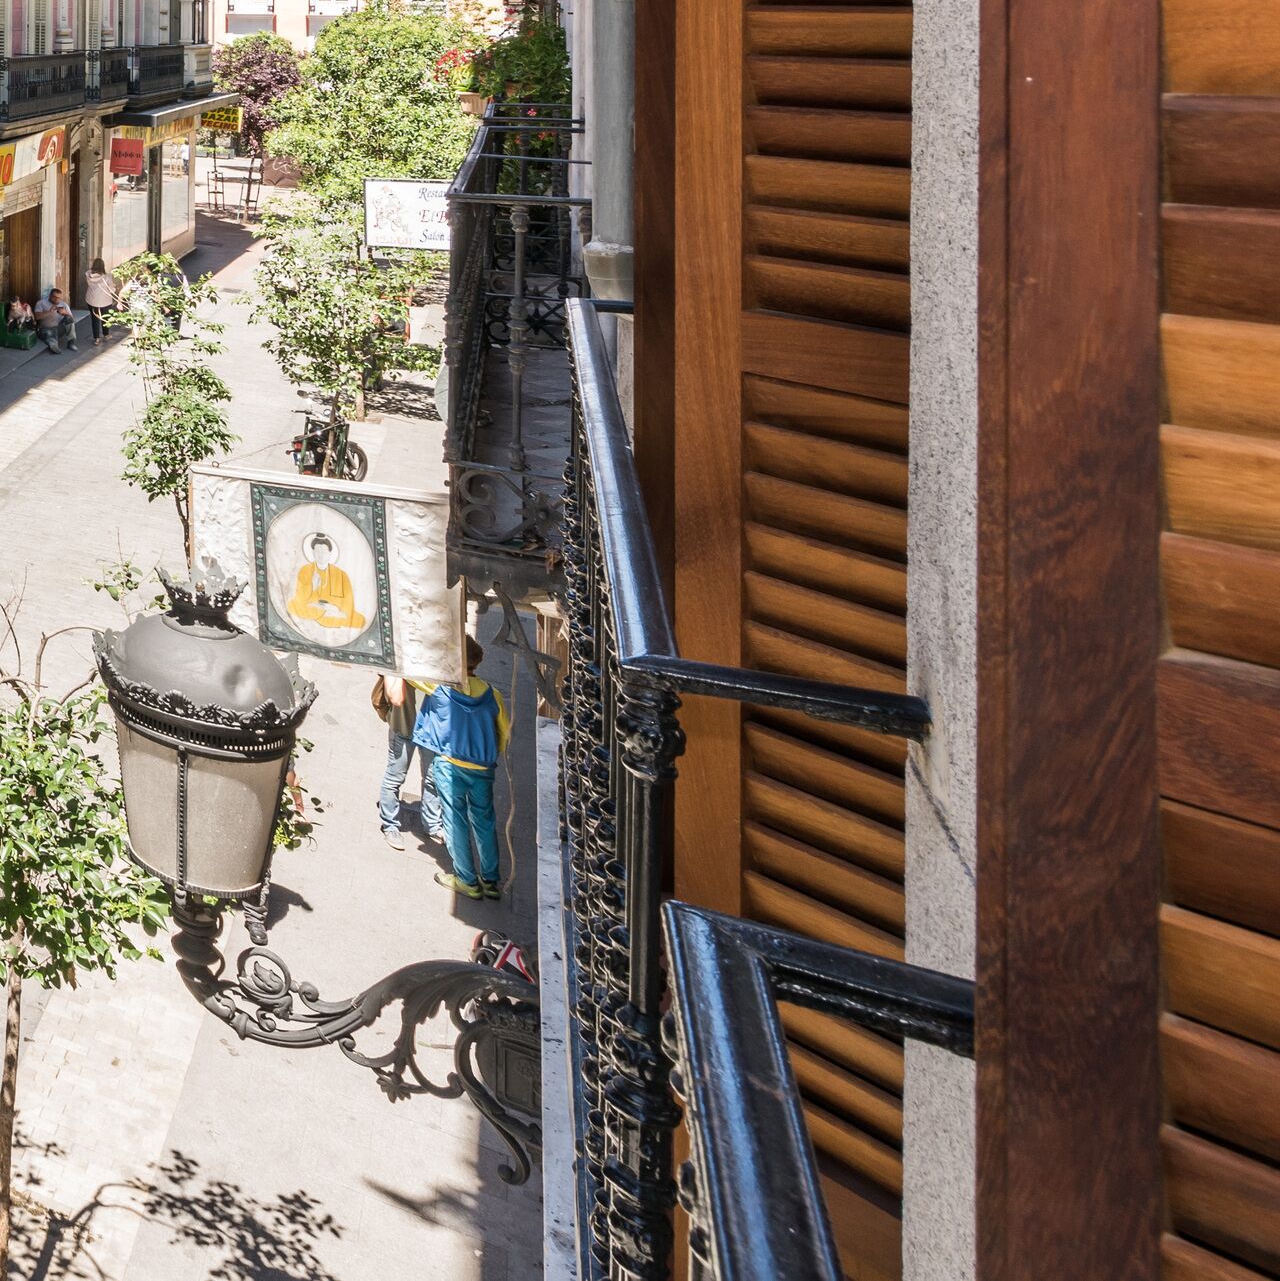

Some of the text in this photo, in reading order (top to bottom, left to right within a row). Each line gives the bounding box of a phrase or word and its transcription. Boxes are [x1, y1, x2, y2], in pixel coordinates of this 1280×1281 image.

[201, 112, 239, 122] BAZAR
[201, 120, 239, 131] VECINO
[419, 187, 446, 202] Resta
